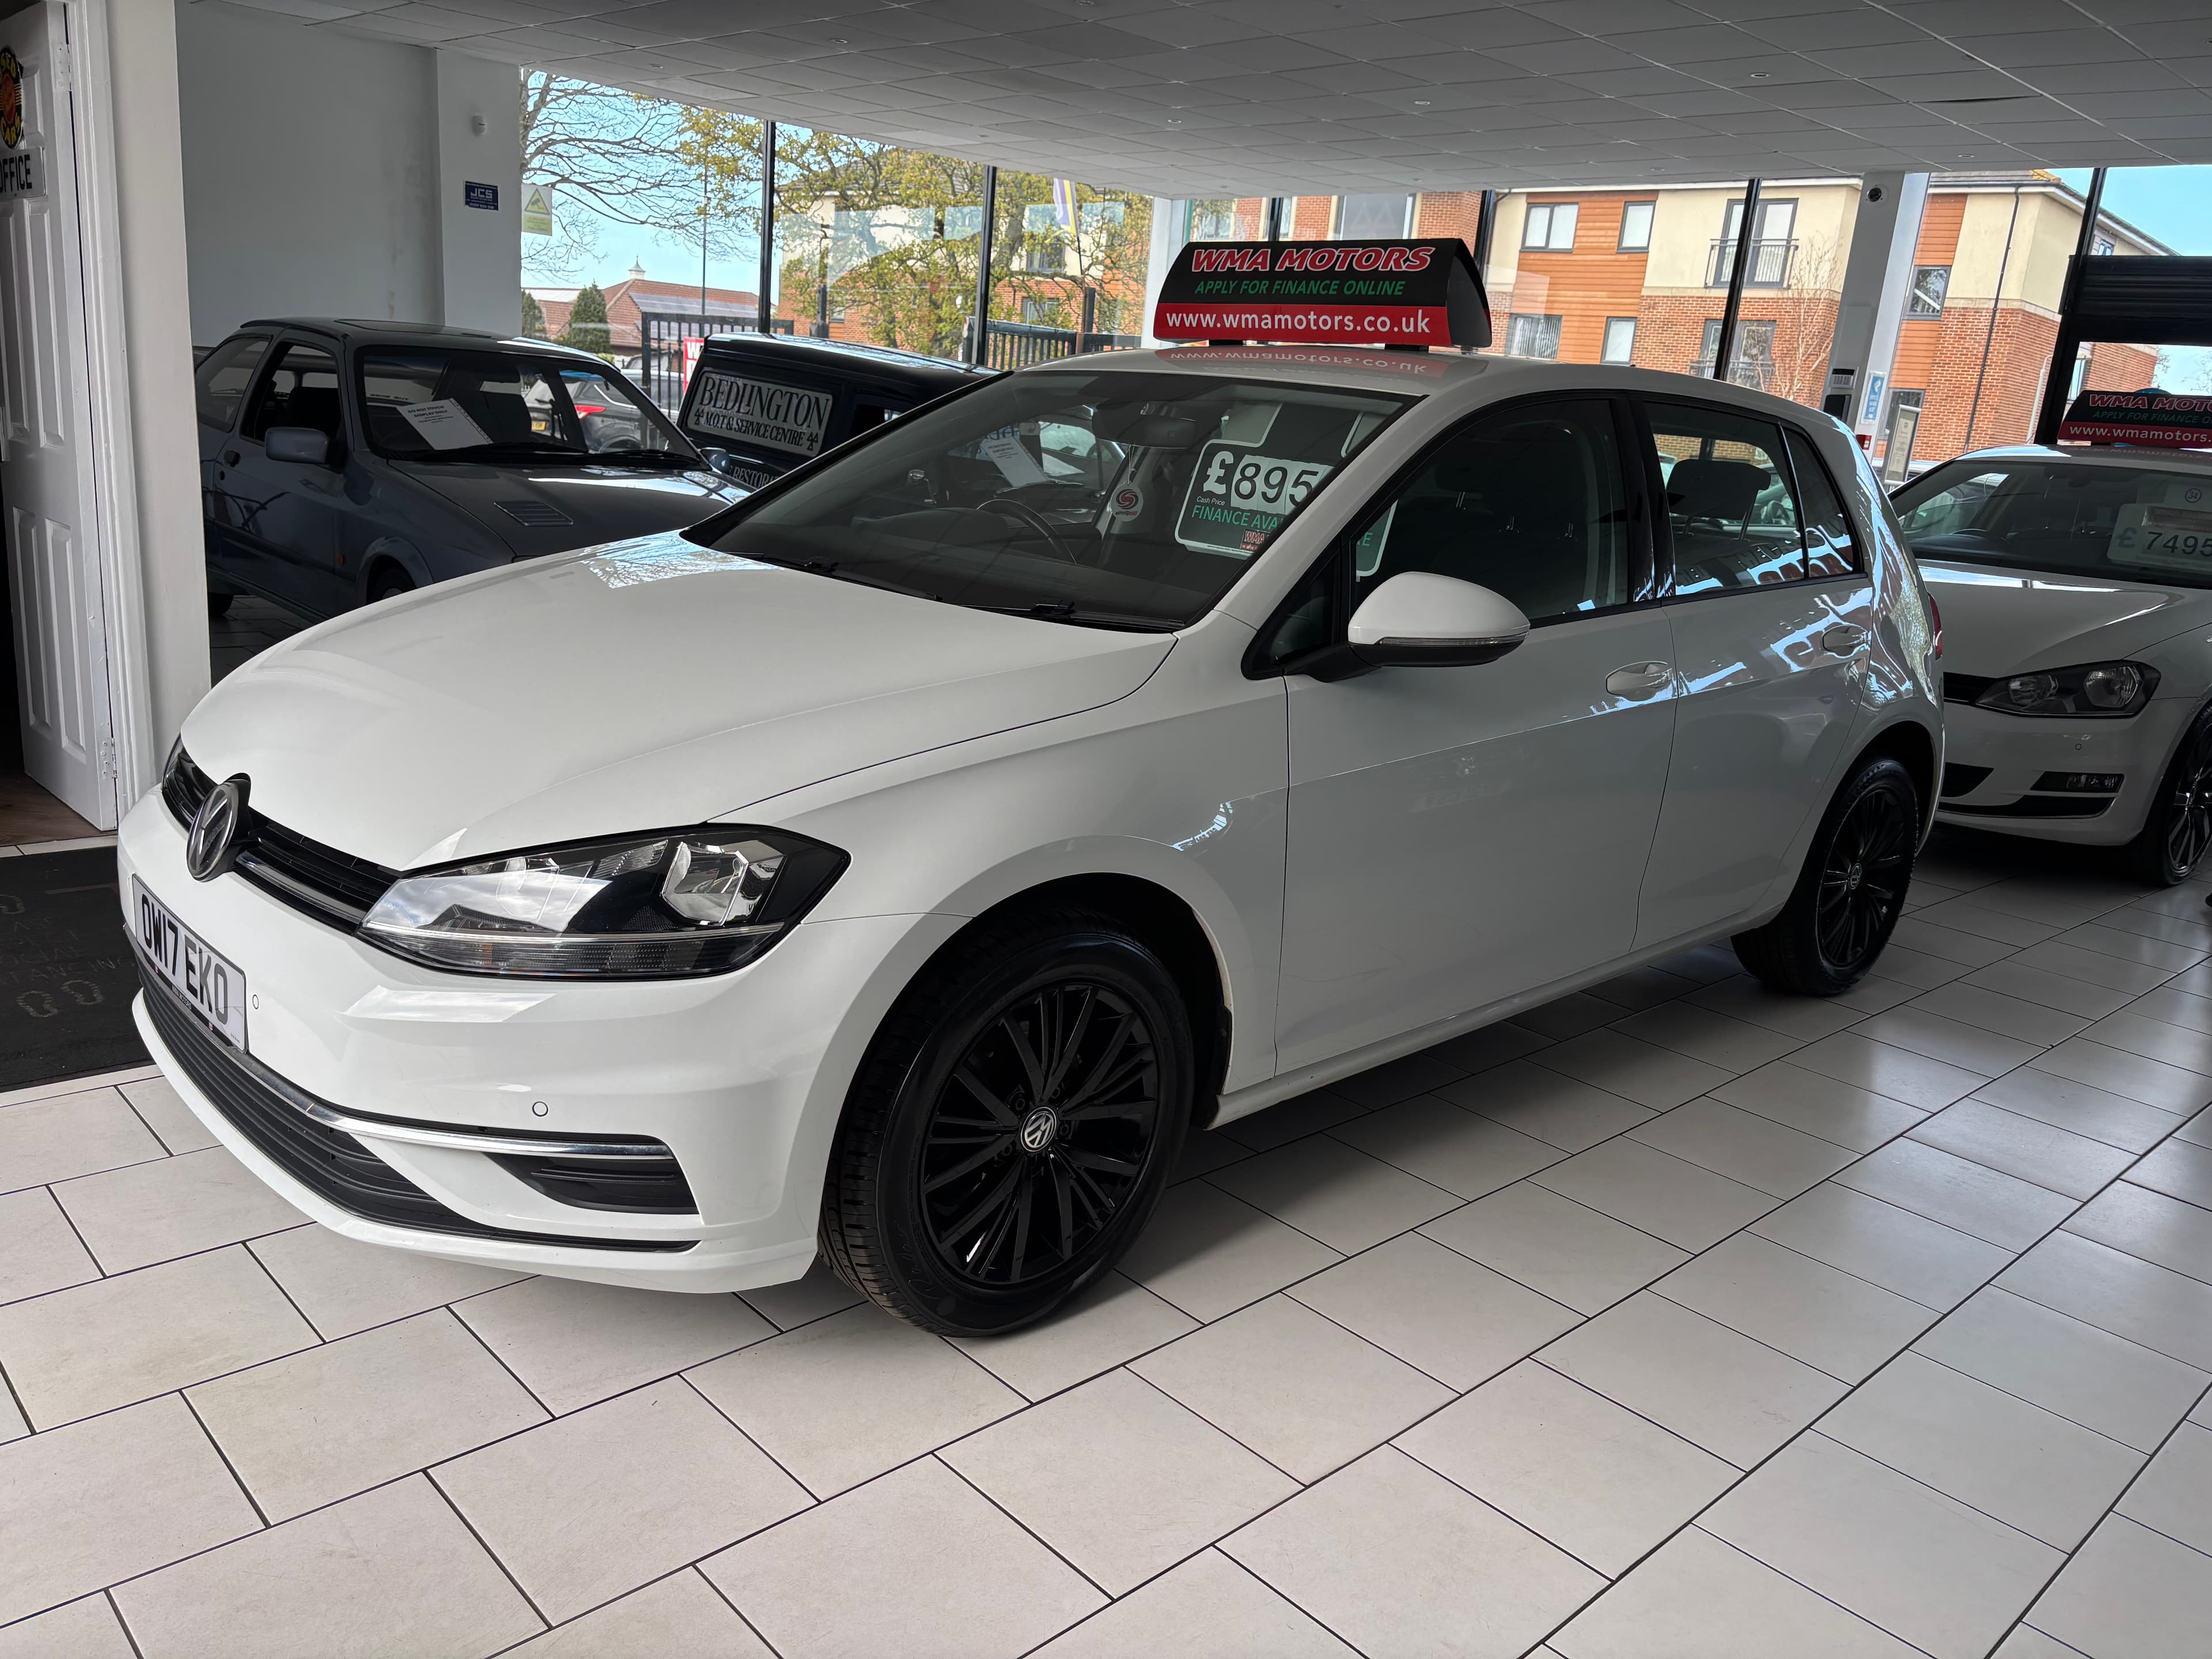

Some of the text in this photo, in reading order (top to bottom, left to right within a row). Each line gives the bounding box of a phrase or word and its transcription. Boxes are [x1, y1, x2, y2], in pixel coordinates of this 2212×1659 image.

[470, 188, 493, 199] JCS
[1191, 246, 1436, 272] WMA MOTORS
[1194, 280, 1406, 296] APPLY FOR FINANCE ONLINE
[1166, 309, 1430, 333] www.wmamotors.co.uk
[698, 376, 830, 430] BEDLINGTON
[2089, 394, 2212, 412] WMA MOT
[2093, 411, 2125, 419] APPLY
[2126, 412, 2148, 421] FOR
[2150, 413, 2199, 424] FINANCE
[726, 416, 734, 430] &
[734, 418, 771, 440] SERVICE
[769, 427, 805, 447] CENTRE
[733, 466, 780, 488] RESTOR
[1196, 496, 1226, 506] Cash Price
[2187, 491, 2199, 500] 34
[1191, 505, 1281, 531] FINANCE AVA
[141, 893, 228, 1025] OW17 EKO
